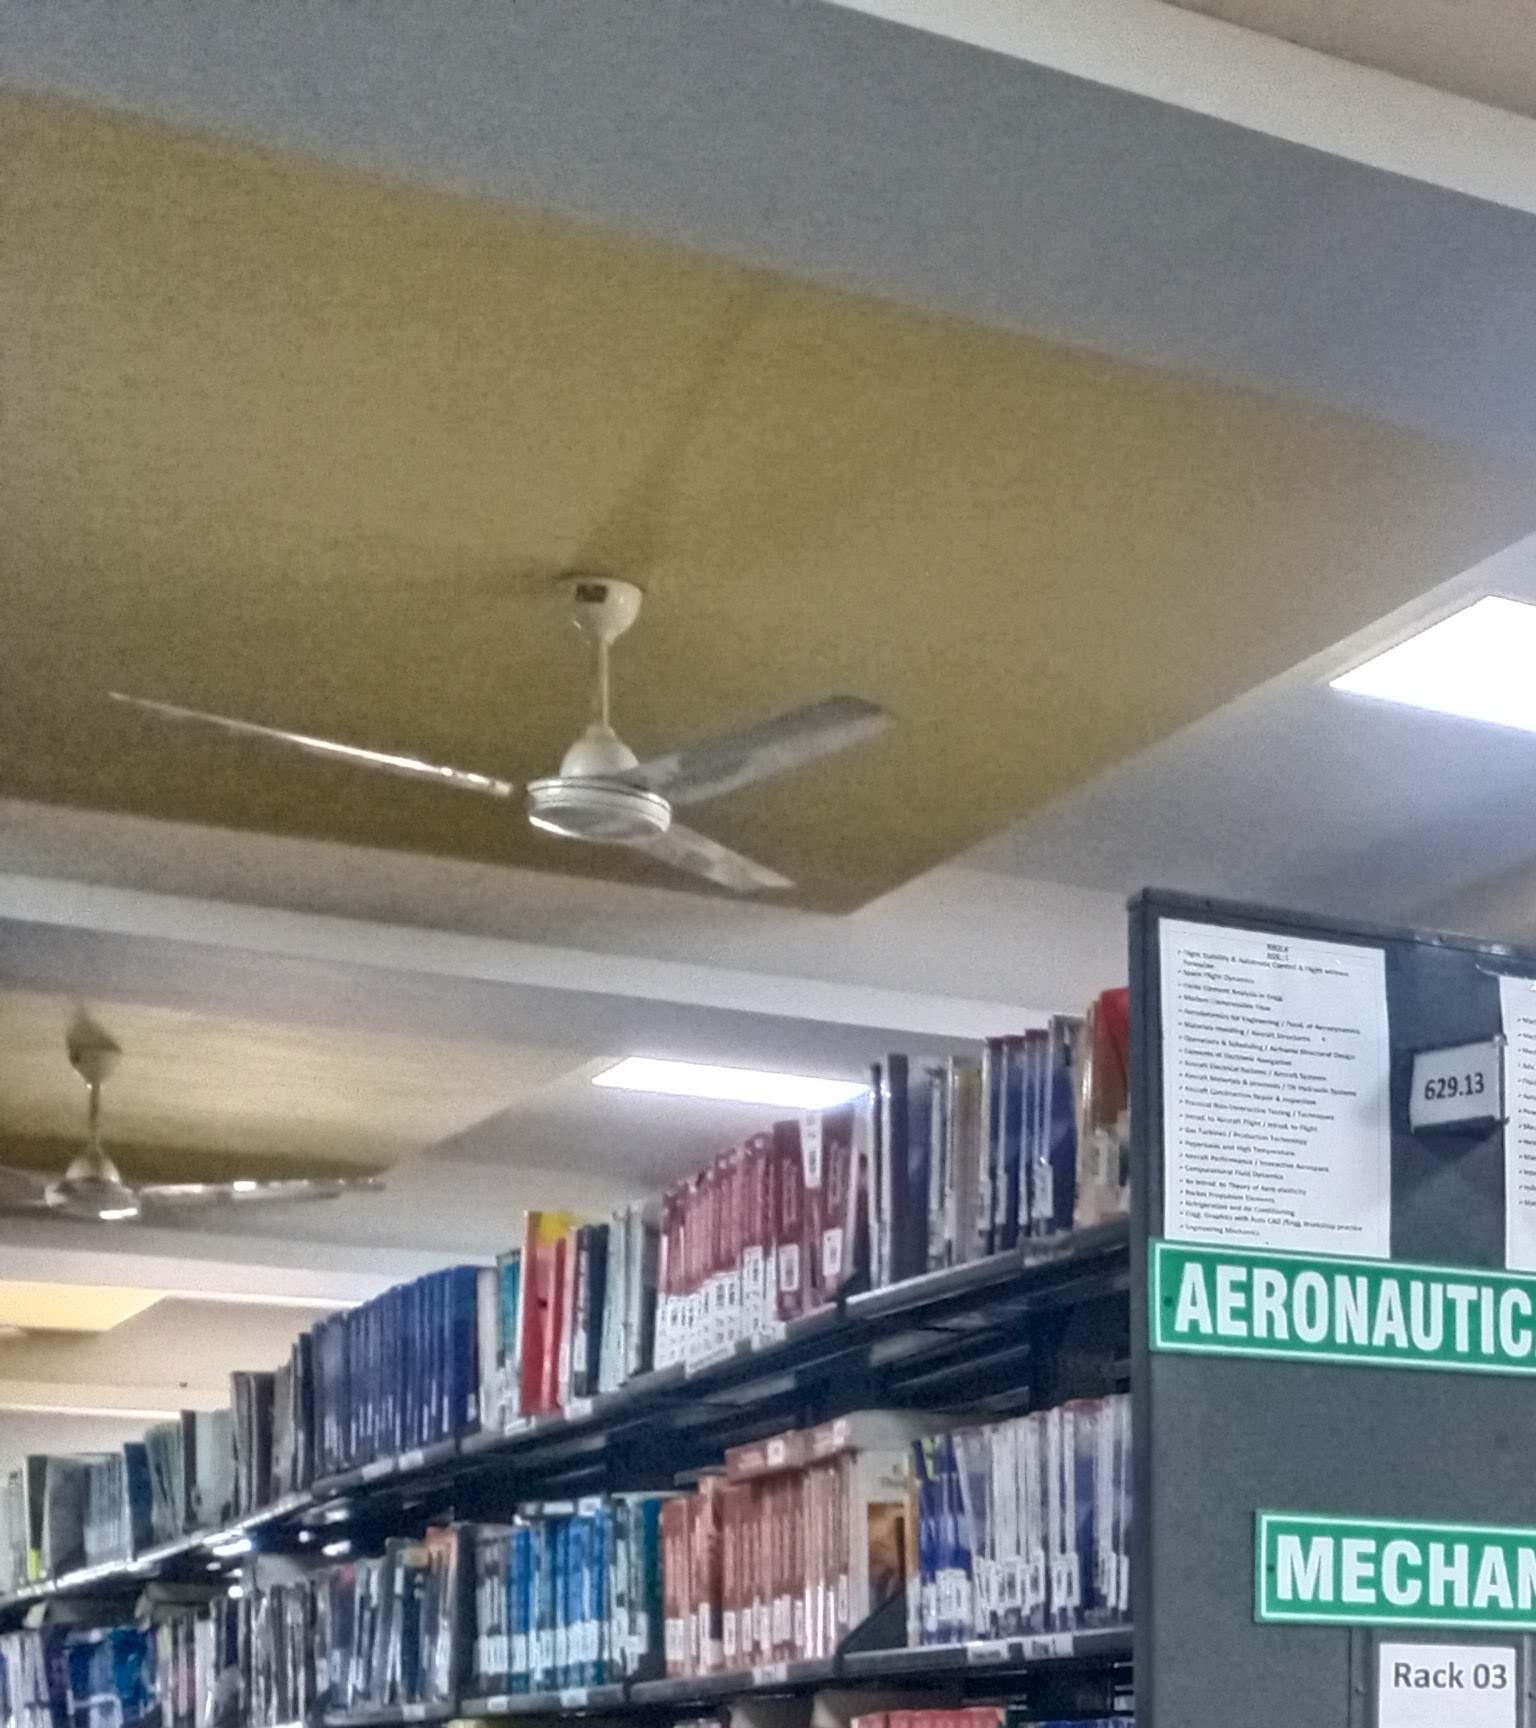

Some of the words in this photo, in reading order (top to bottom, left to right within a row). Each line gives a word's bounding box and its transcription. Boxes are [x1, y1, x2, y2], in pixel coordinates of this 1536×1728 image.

[1424, 1073, 1486, 1101] 629.13
[1393, 1661, 1465, 1690] Rack
[1473, 1663, 1508, 1690] 03
